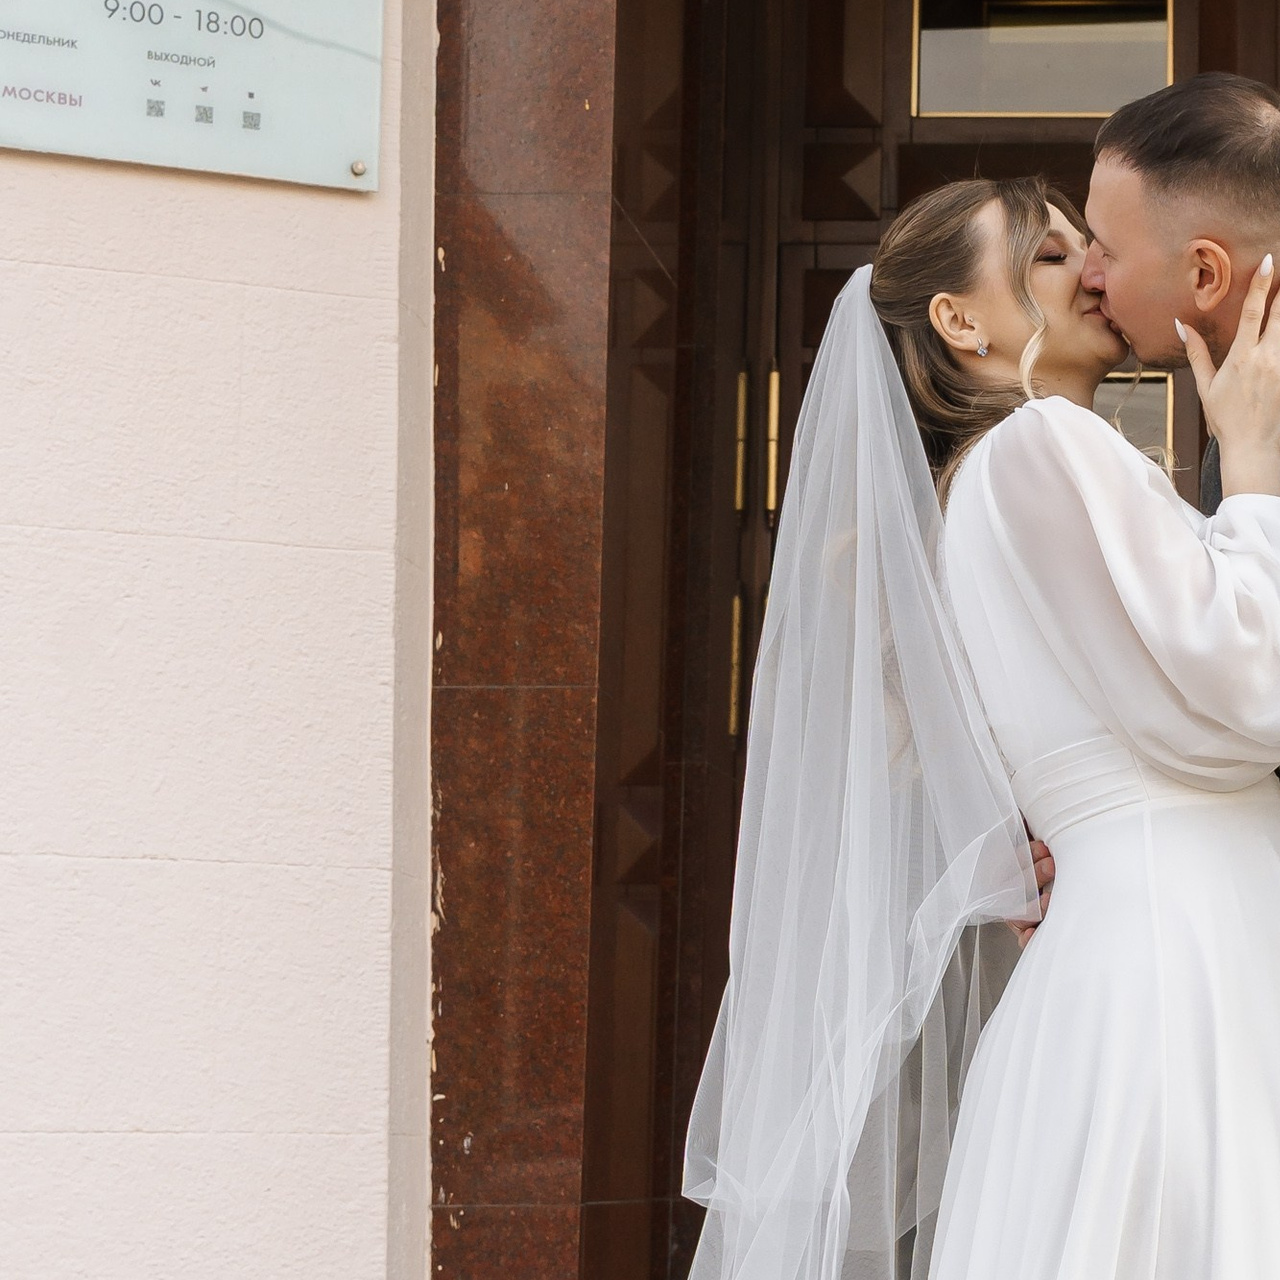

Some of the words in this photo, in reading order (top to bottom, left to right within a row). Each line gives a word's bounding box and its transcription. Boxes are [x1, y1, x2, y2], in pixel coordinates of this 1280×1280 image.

[195, 9, 264, 39] 18:00
[147, 50, 216, 68] ВЫХОДНОЙ
[2, 85, 83, 107] МОСКВЫ
